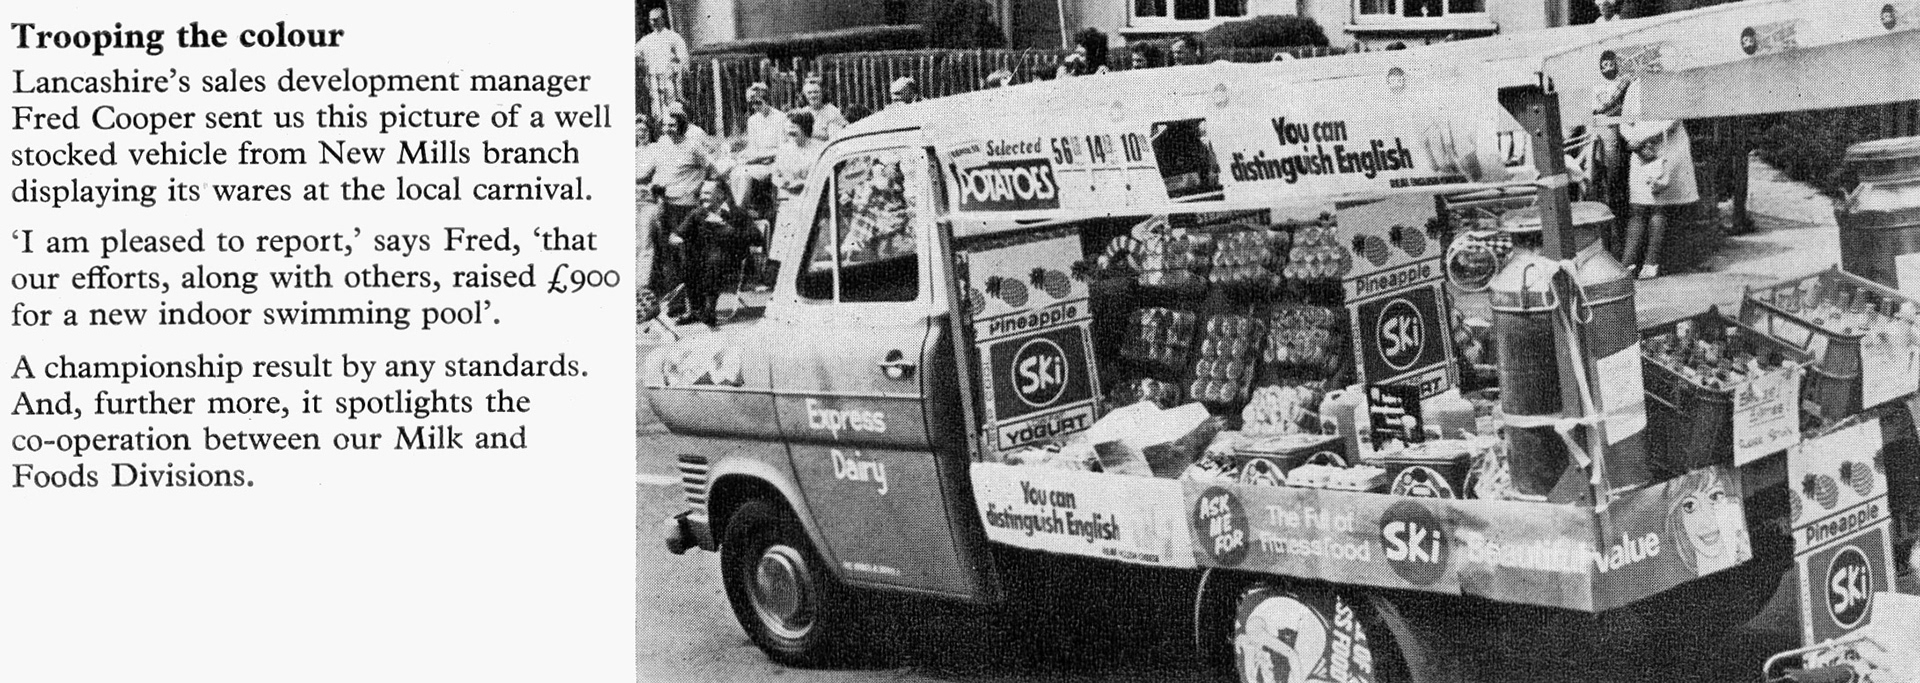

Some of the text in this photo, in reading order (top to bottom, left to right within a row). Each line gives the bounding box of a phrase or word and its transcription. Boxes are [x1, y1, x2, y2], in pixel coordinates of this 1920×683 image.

[10, 20, 345, 57] Trooping the colour
[201, 67, 267, 93] sales
[277, 67, 460, 98] development
[469, 74, 591, 98] manager
[11, 103, 612, 136] Fred Cooper sent us this picture of a well
[1272, 116, 1348, 146] You can
[11, 139, 580, 167] stocked vehicle from New Mills branch
[986, 137, 1042, 157] Selected
[1230, 138, 1414, 184] distinguish English
[11, 175, 592, 209] displaying its wares at the local carnival.
[959, 165, 1055, 205] POTATOES
[46, 236, 90, 254] am
[100, 227, 206, 259] pleased
[216, 232, 245, 253] to
[374, 234, 431, 258] says
[443, 226, 521, 257] Fred,
[11, 273, 60, 290] our
[71, 264, 170, 294] efforts,
[181, 264, 259, 295] along
[269, 263, 334, 289] with
[344, 263, 441, 293] others,
[452, 263, 537, 288] raised
[1355, 262, 1431, 297] Pineapple
[11, 302, 53, 327] for
[63, 309, 79, 327] a
[89, 308, 148, 326] new
[158, 300, 253, 326] indoor
[263, 299, 411, 331] swimming
[988, 304, 1078, 336] Pineapple
[10, 352, 588, 385] A championship result by any standards.
[10, 388, 531, 420] And, further more, it spotlights the
[805, 397, 886, 439] Express
[11, 424, 528, 458] co-operation between our Milk and
[1006, 412, 1088, 445] YOGURT
[12, 462, 254, 489] Foods Divisions.
[831, 449, 889, 496] Dairy
[1020, 480, 1076, 509] You can
[1200, 494, 1230, 520] ASK
[985, 502, 1121, 544] distinguish English
[1210, 513, 1232, 538] ME
[1266, 504, 1300, 528] The
[1334, 511, 1355, 533] of
[1805, 503, 1879, 546] Pineapple
[1214, 529, 1243, 556] FOR
[1592, 531, 1661, 573] value
[1330, 629, 1352, 683] FOOD
